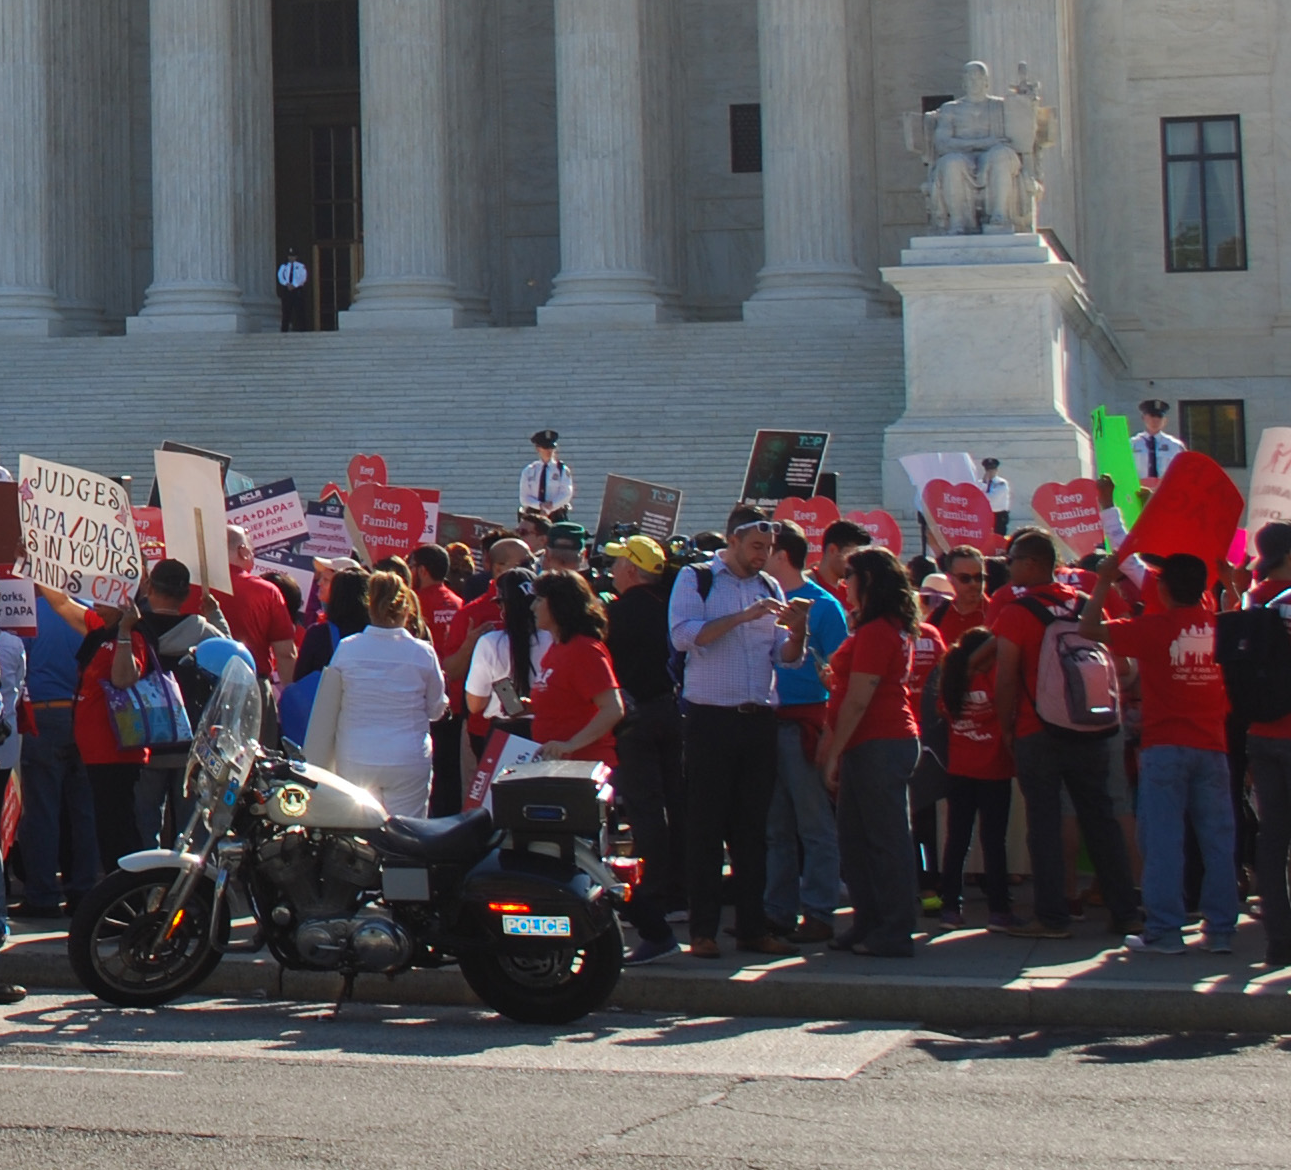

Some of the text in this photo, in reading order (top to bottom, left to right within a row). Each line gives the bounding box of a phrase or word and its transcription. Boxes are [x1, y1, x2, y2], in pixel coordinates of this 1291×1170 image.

[359, 465, 375, 476] Keep
[239, 490, 262, 502] NCLR
[943, 493, 968, 507] Keep
[1055, 492, 1083, 505] Keep
[373, 498, 401, 514] Keep
[227, 502, 295, 526] ACA+DAPA=
[266, 516, 283, 526] FOR
[793, 510, 817, 522] Keep
[937, 508, 978, 522] Families
[1050, 507, 1097, 521] Families
[266, 520, 304, 536] FAMILIES
[362, 514, 409, 531] Families
[69, 540, 139, 579] YOURS
[19, 556, 82, 594] HANDS
[1, 592, 26, 603] orks,
[5, 606, 34, 616] DAPA
[469, 771, 488, 801] NCLR
[506, 918, 568, 933] POLICE
